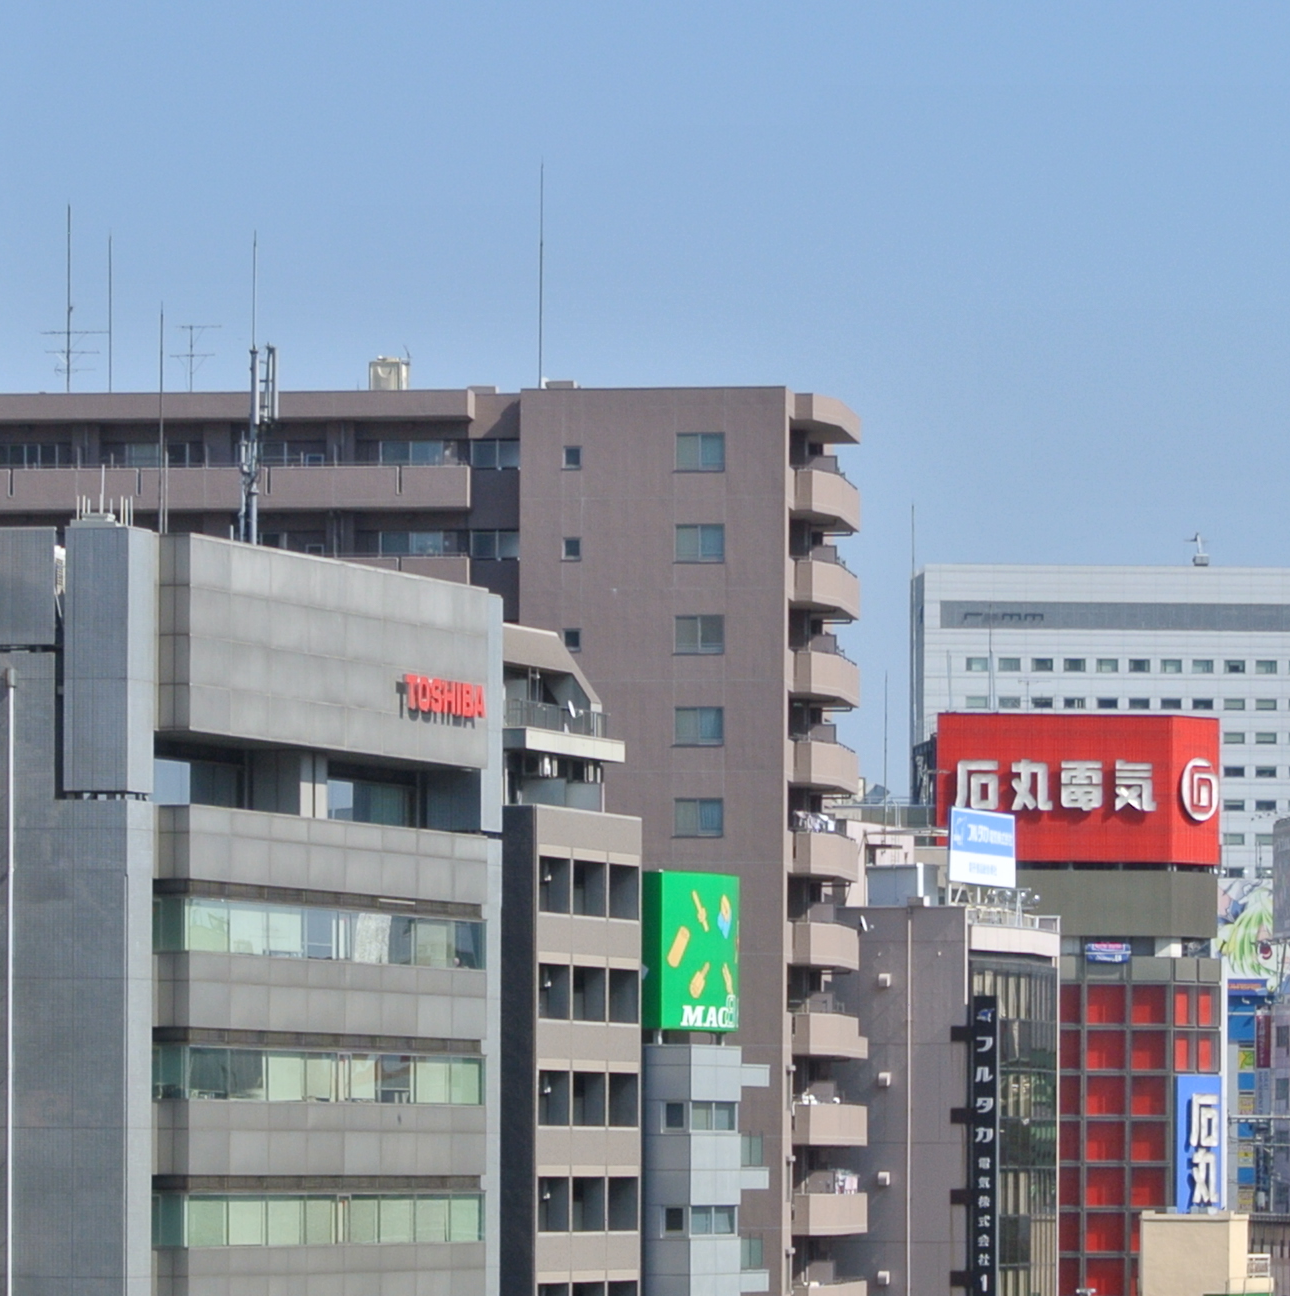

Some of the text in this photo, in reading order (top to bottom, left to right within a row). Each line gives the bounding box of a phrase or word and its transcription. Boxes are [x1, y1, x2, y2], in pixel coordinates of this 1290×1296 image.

[404, 673, 487, 718] TOSHIBA
[955, 758, 1157, 812] 石丸電気
[1190, 1093, 1219, 1204] 石丸
